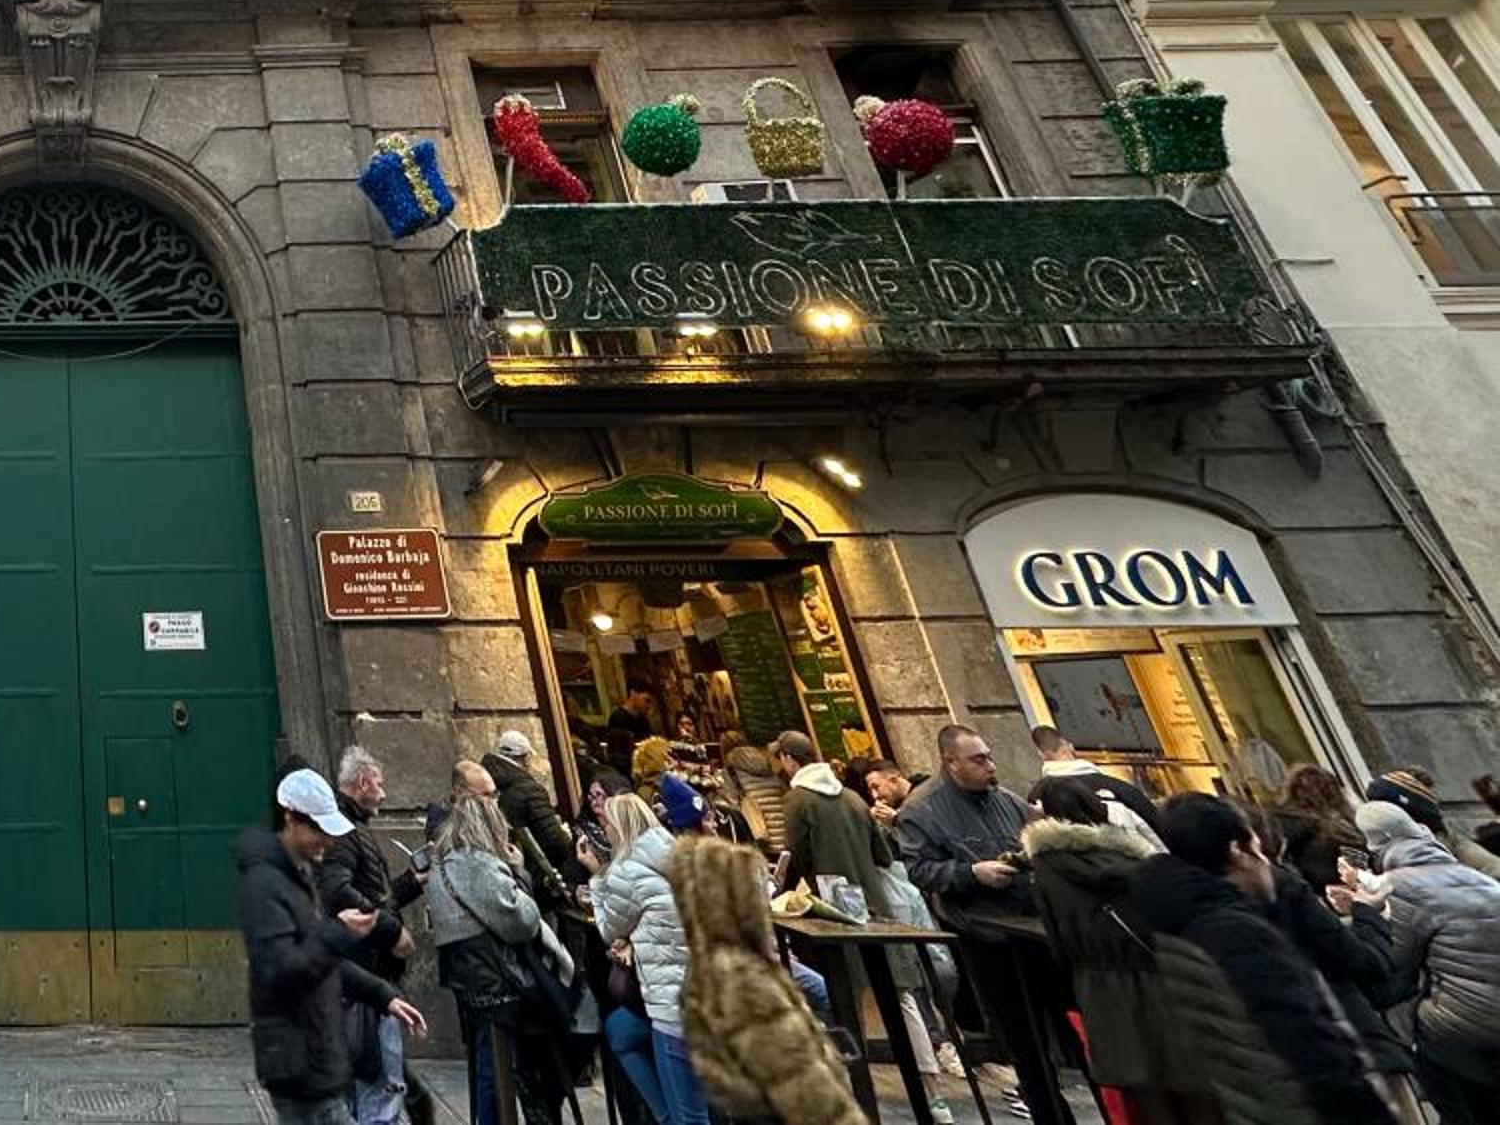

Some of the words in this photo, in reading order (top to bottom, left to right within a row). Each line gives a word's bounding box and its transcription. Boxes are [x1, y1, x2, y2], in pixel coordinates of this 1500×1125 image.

[531, 259, 919, 321] PASSIONE
[925, 259, 1022, 316] DI
[583, 504, 668, 521] PASSIONE
[675, 505, 694, 519] DI
[348, 535, 391, 549] Palazzo
[396, 534, 407, 548] di
[330, 551, 383, 564] Domenico
[386, 549, 430, 565] Barbaja
[401, 567, 411, 579] di
[1020, 549, 1256, 608] GROM
[391, 580, 425, 593] Rossini
